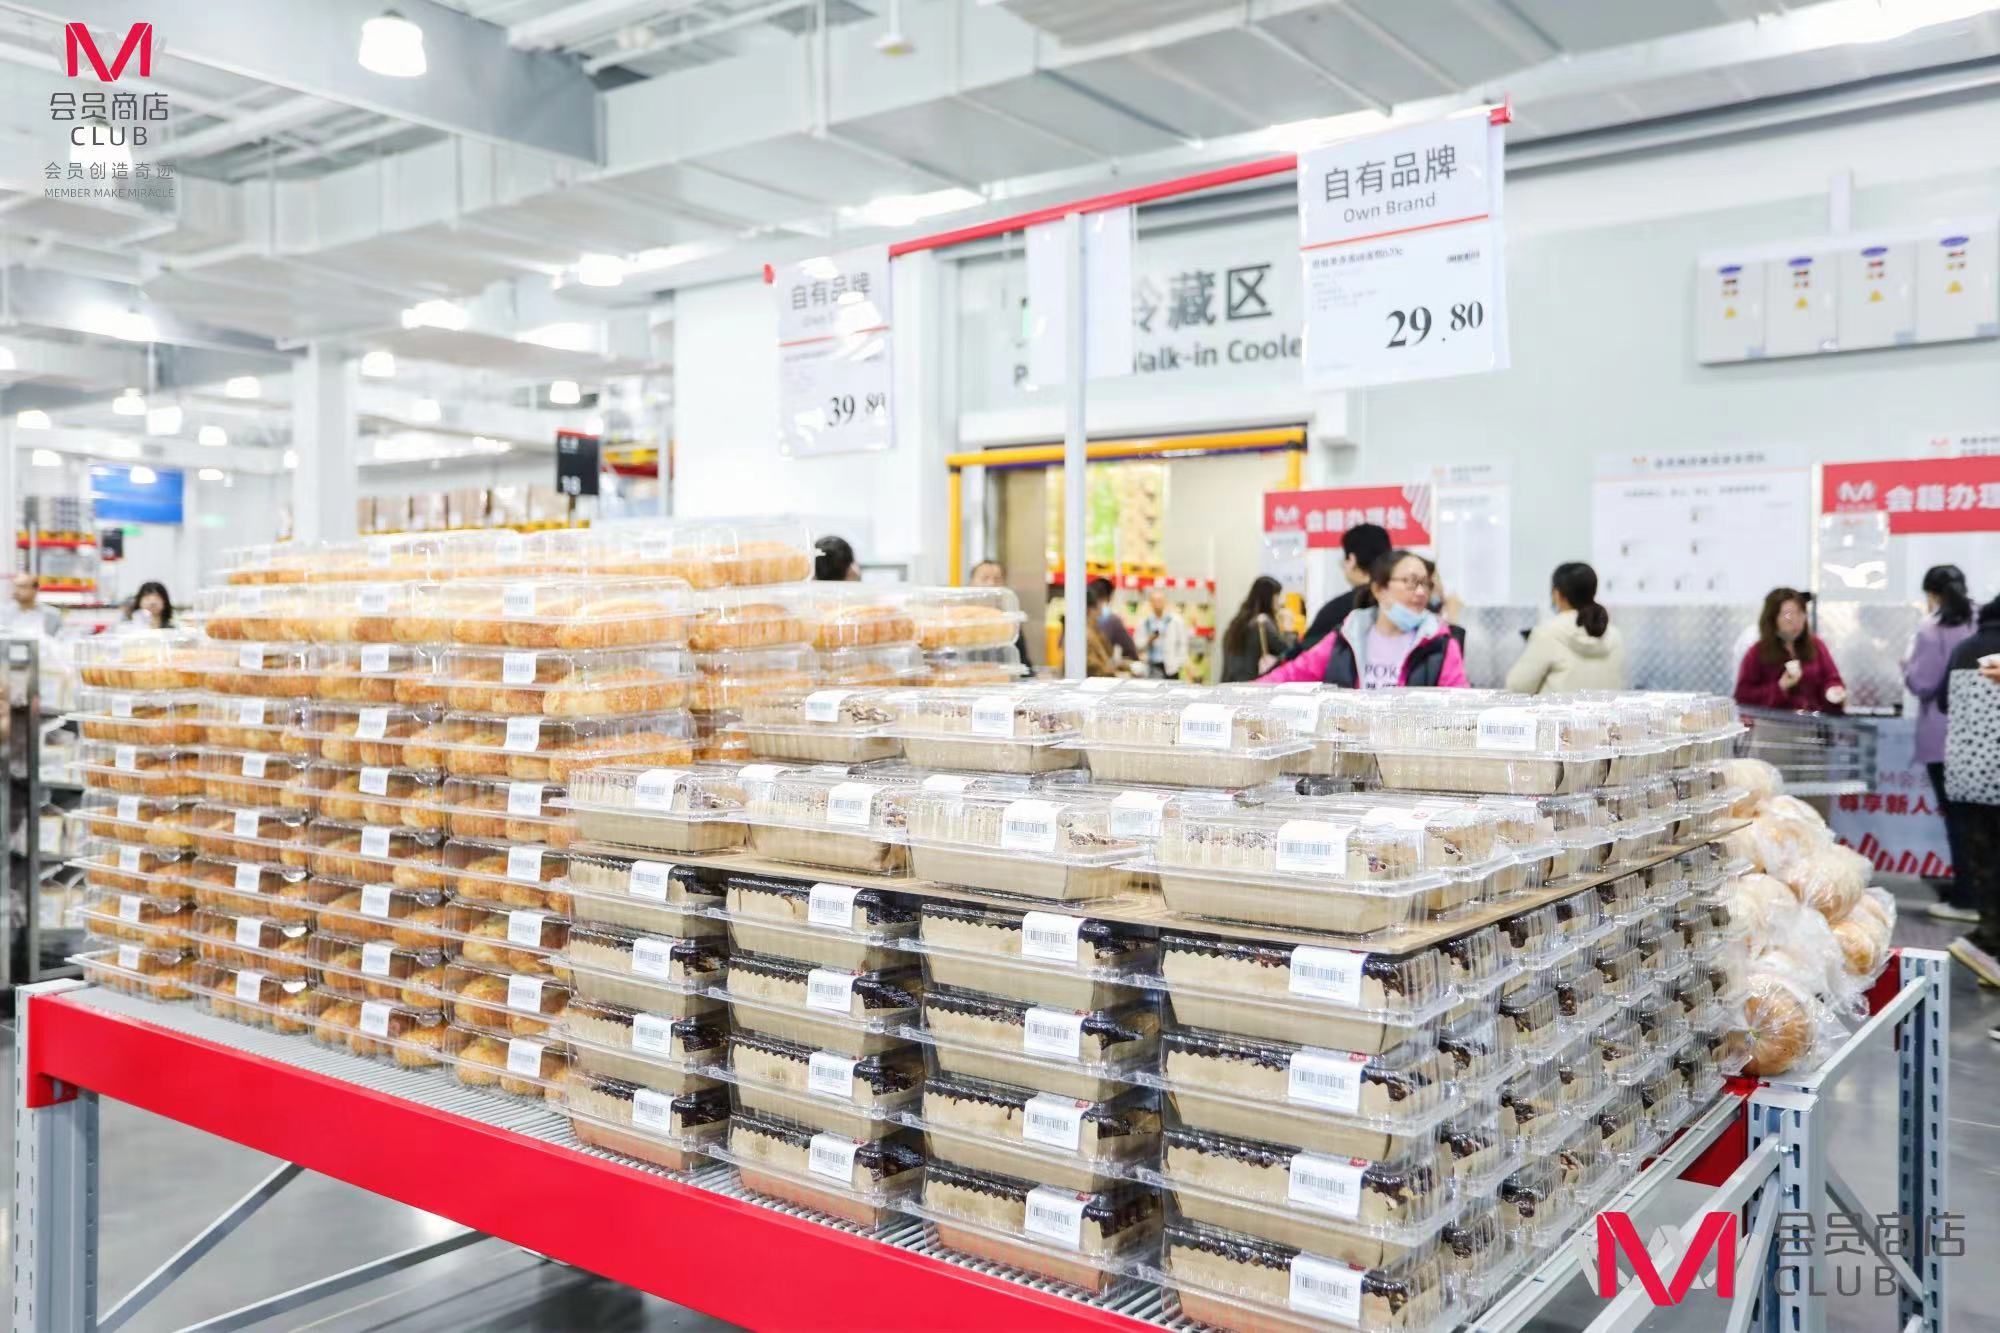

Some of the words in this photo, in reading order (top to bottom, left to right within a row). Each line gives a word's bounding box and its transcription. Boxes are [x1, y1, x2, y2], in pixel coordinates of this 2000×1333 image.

[1324, 143, 1458, 203] 自有品牌
[1343, 202, 1381, 223] Own
[1386, 192, 1437, 214] Brand
[1133, 343, 1218, 374] alk-in
